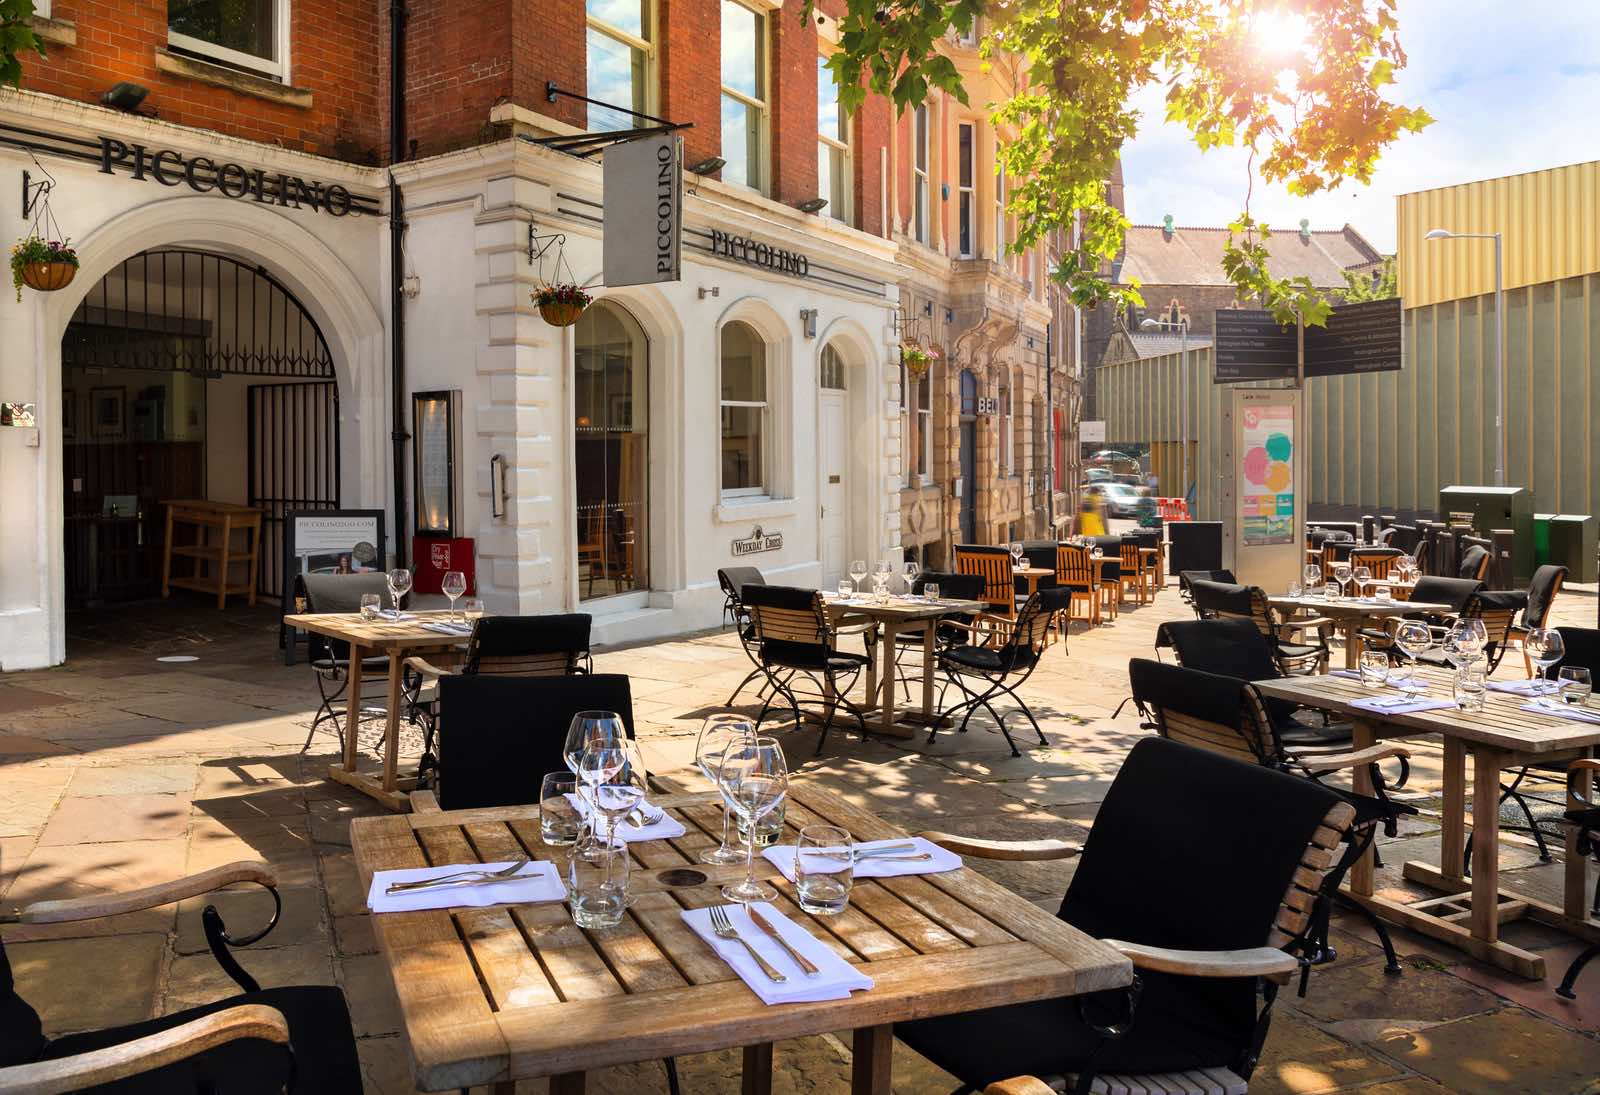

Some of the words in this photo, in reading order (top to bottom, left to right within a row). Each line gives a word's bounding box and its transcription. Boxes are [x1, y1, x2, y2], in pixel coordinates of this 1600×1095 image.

[97, 135, 352, 217] PICCOLINO
[656, 145, 672, 274] PICCOLINO
[711, 229, 809, 276] PICCOLINO
